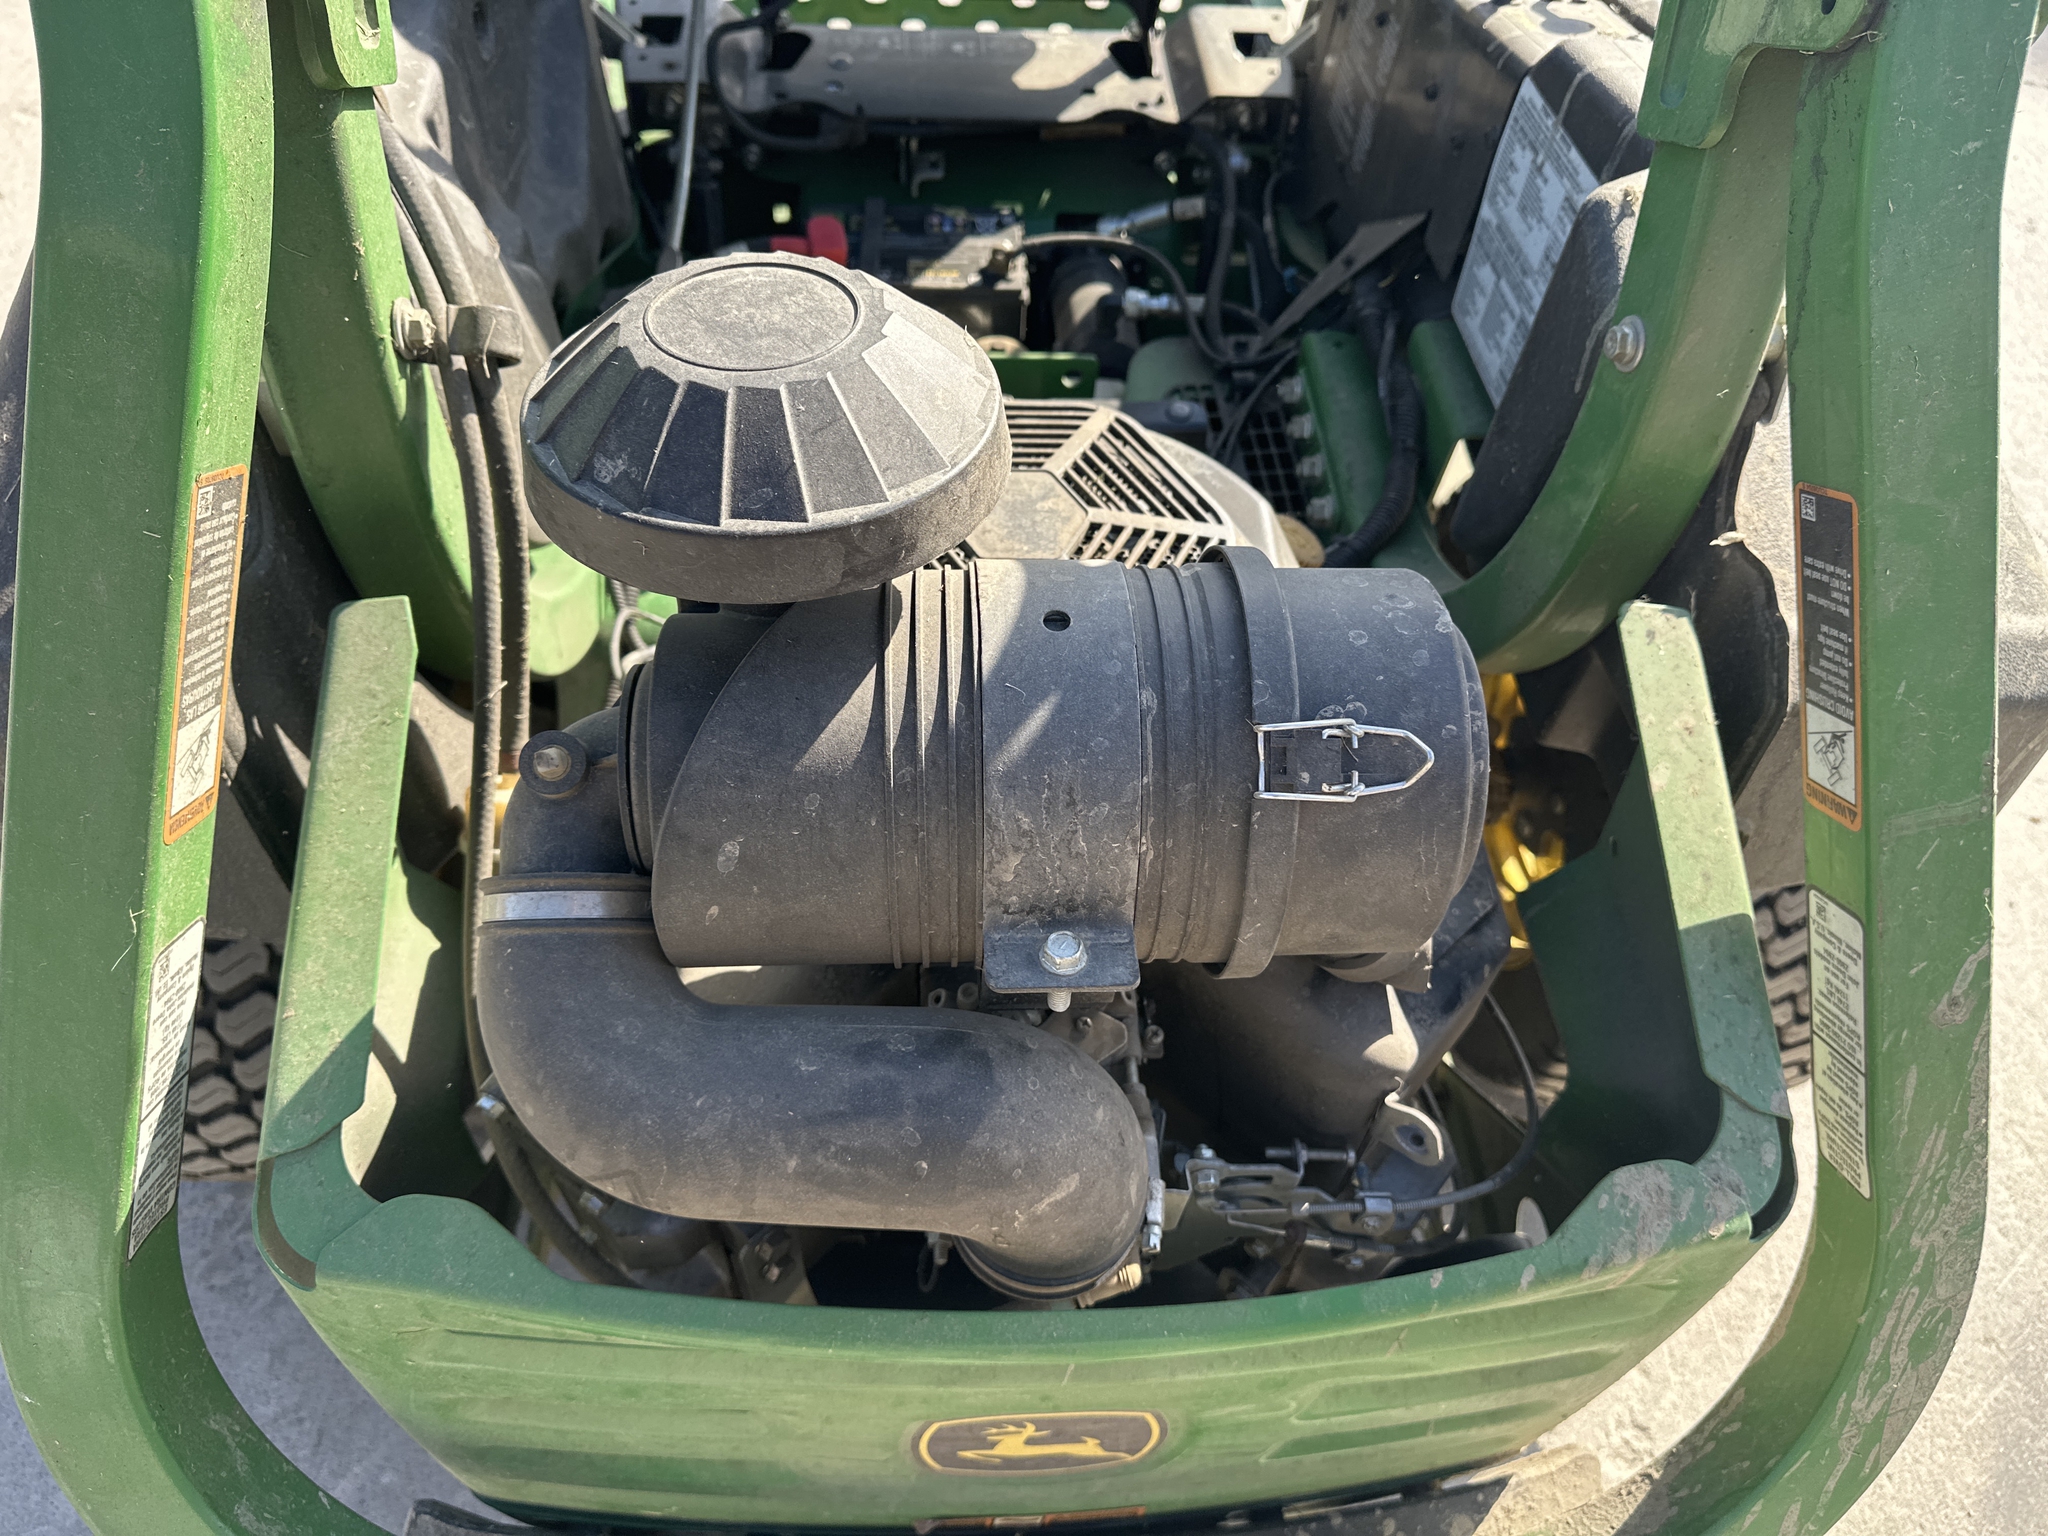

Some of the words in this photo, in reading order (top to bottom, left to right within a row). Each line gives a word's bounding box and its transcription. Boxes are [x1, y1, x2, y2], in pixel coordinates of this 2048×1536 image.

[1805, 686, 1834, 712] CRUSHING
[1835, 701, 1853, 721] AVOID
[1806, 781, 1846, 820] WARNING
